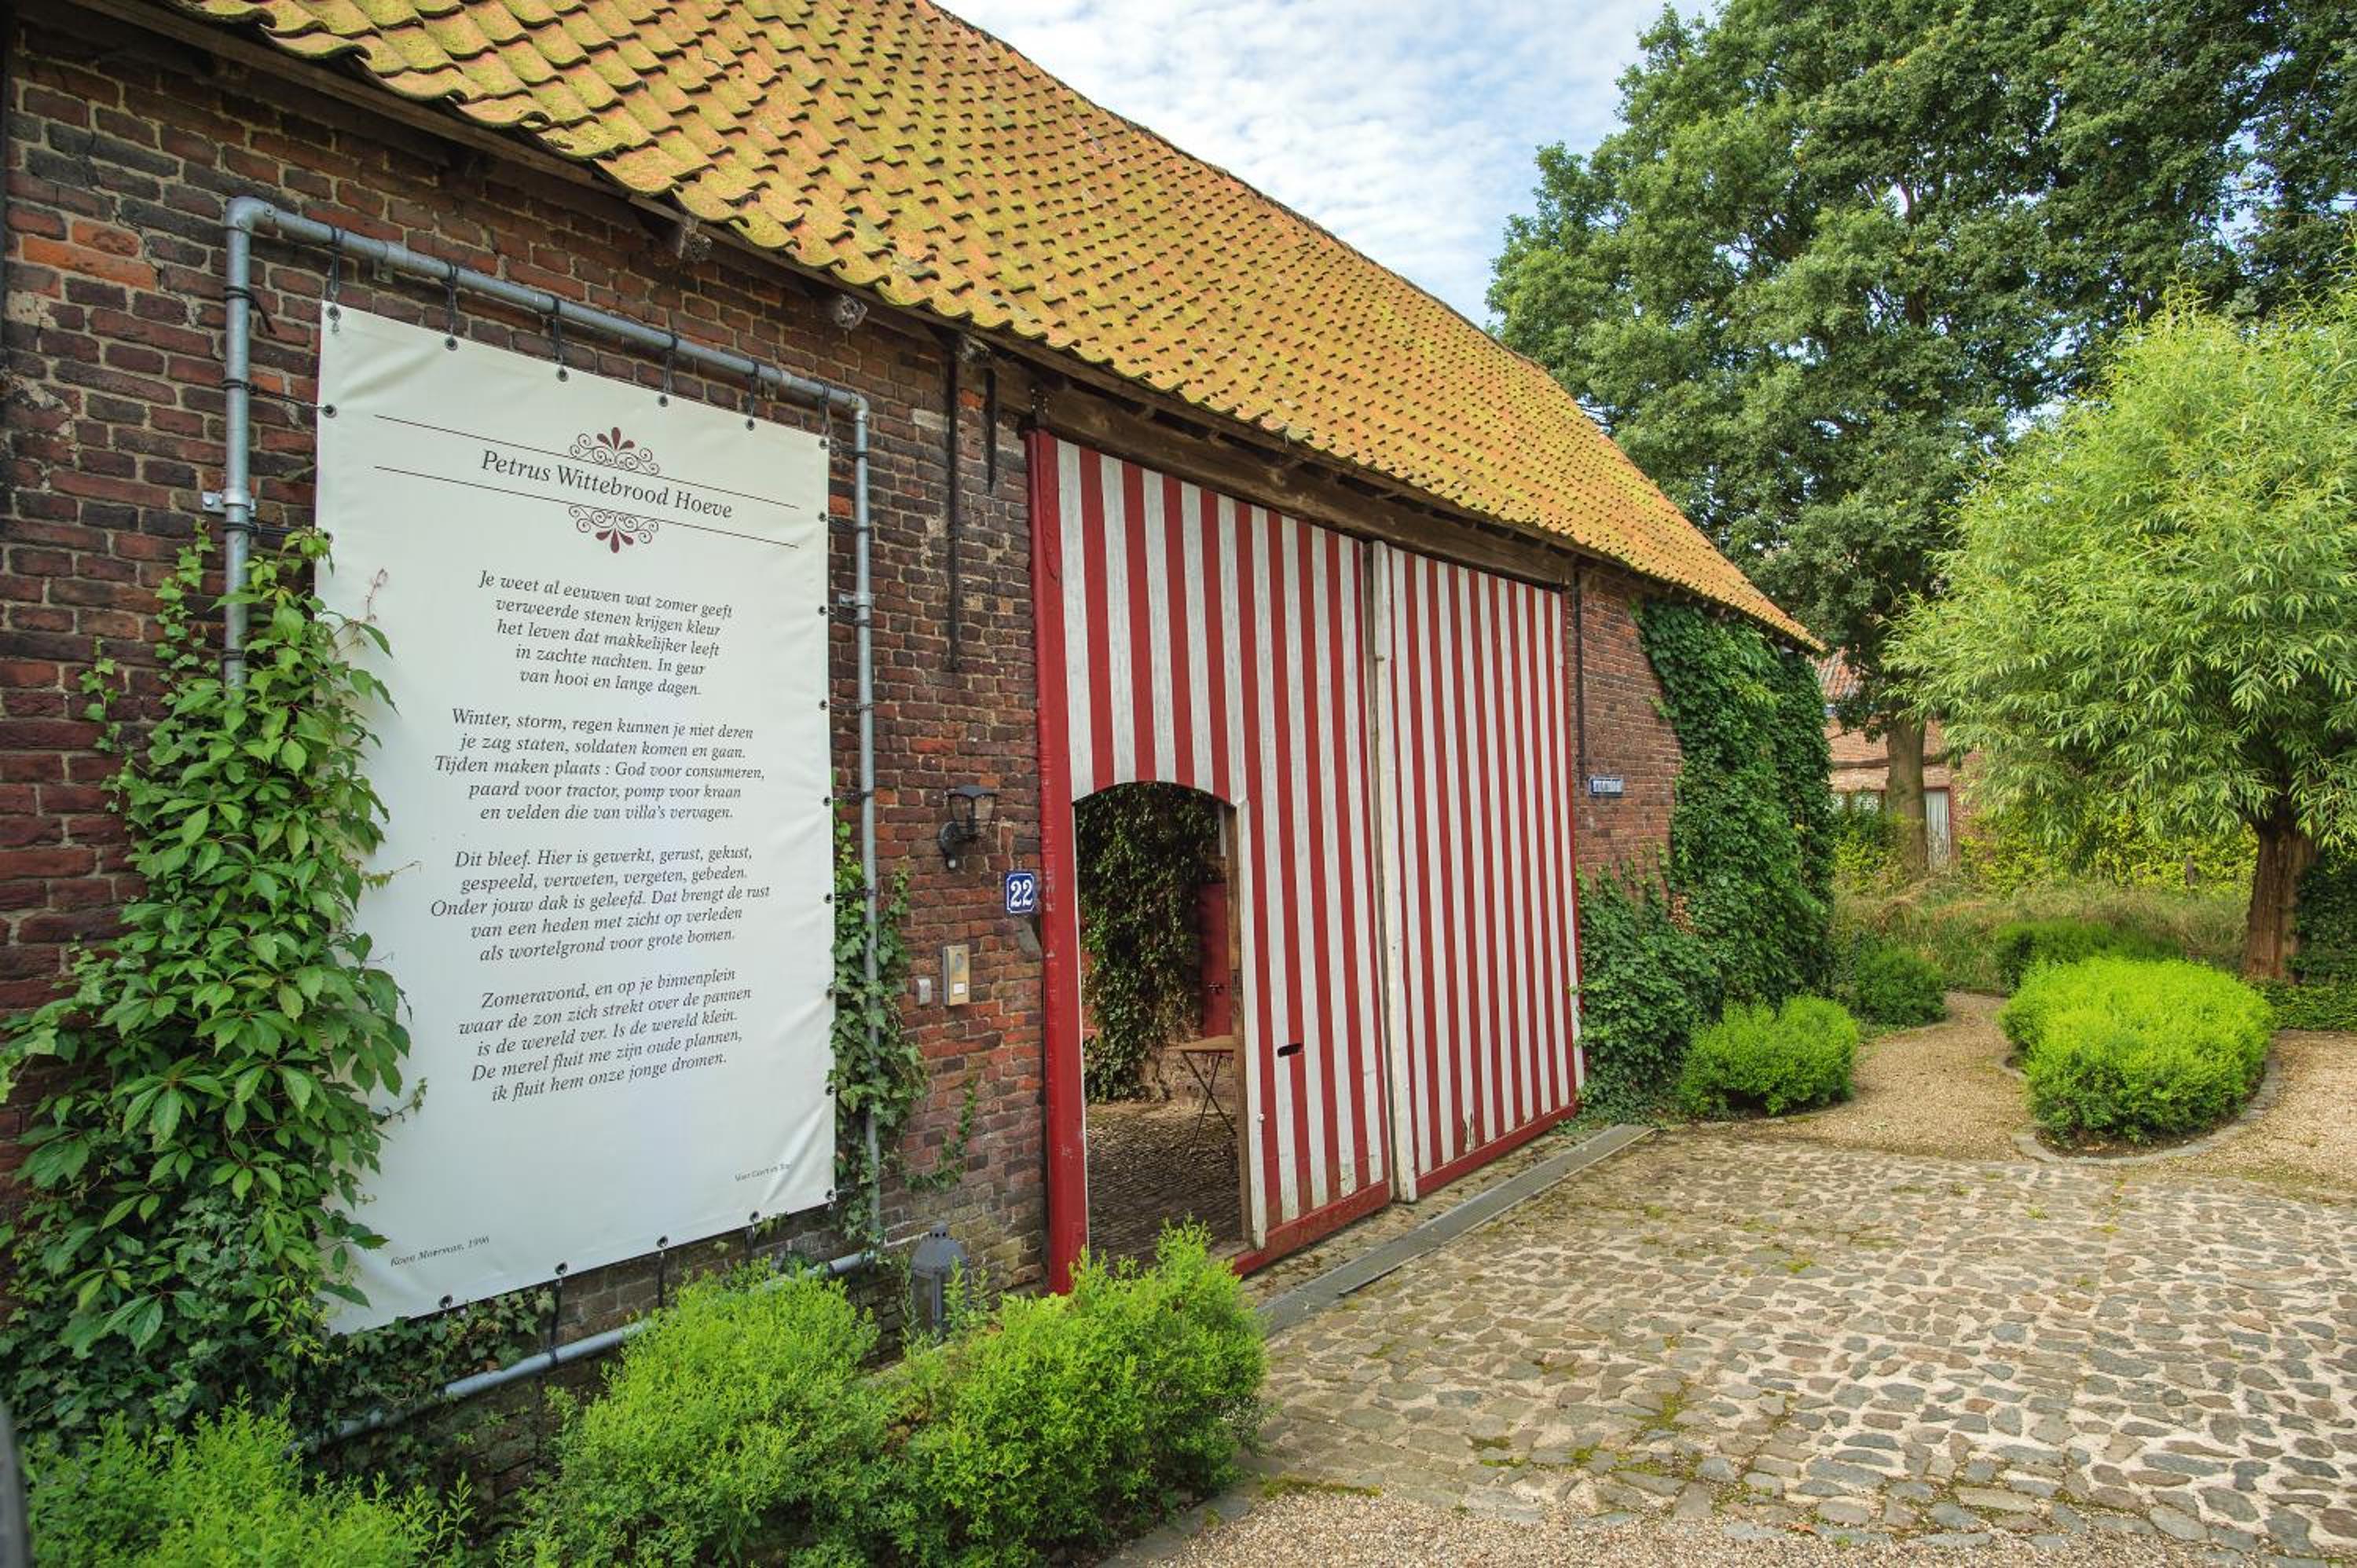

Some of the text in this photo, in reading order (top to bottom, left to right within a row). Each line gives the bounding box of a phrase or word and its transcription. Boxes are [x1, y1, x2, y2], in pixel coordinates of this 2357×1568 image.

[480, 449, 732, 518] Petrus Wittebrood Hoeve
[477, 570, 732, 621] Je weet al eeuwen wat zomer geeft
[495, 599, 721, 636] verweerde stenen krijgen kleur
[497, 618, 720, 659] het leven dat makkelijker leeft
[515, 643, 706, 677] in zachte nachten. In geur
[519, 669, 702, 698] van hooi en lange dagen.
[452, 708, 753, 740] Winter, storm, regen kunnen je niet deren
[458, 732, 746, 761] je zag staten, soldaten komen en gaan.
[434, 755, 489, 776] Tijden
[493, 758, 550, 774] maken
[553, 759, 601, 779] plaats
[614, 761, 647, 777] God
[650, 766, 683, 777] voor
[684, 768, 764, 781] consumeren,
[467, 780, 741, 802] paard voor tractor, pomp voor kraan
[479, 808, 501, 820] en
[505, 803, 560, 820] velden
[564, 804, 588, 820] die
[593, 808, 621, 820] van
[669, 808, 733, 822] vervagen.
[454, 844, 753, 870] Dit bleef. Hier is gewerkt, gerust, gekust,
[460, 865, 747, 896] gespeeld, verweten, vergeten, gebeden.
[1010, 879, 1033, 907] 22
[430, 885, 770, 918] Onder jouw dak is geleefd. Dat brengt de rust
[471, 906, 742, 940] van een heden met zicht op verleden
[479, 929, 735, 962] als wortelgrond voor grote bomen.
[481, 967, 736, 1009] Zomeravond, en op je binnenplein
[458, 989, 751, 1035] waar de zon zich strekt over de pannen
[477, 1008, 738, 1057] is de wereld ver. Is de wereld klein.
[471, 1030, 742, 1082] De merel fluit me zijn oude plannen,
[492, 1053, 727, 1102] ik fluit hem onze jonge dromen.
